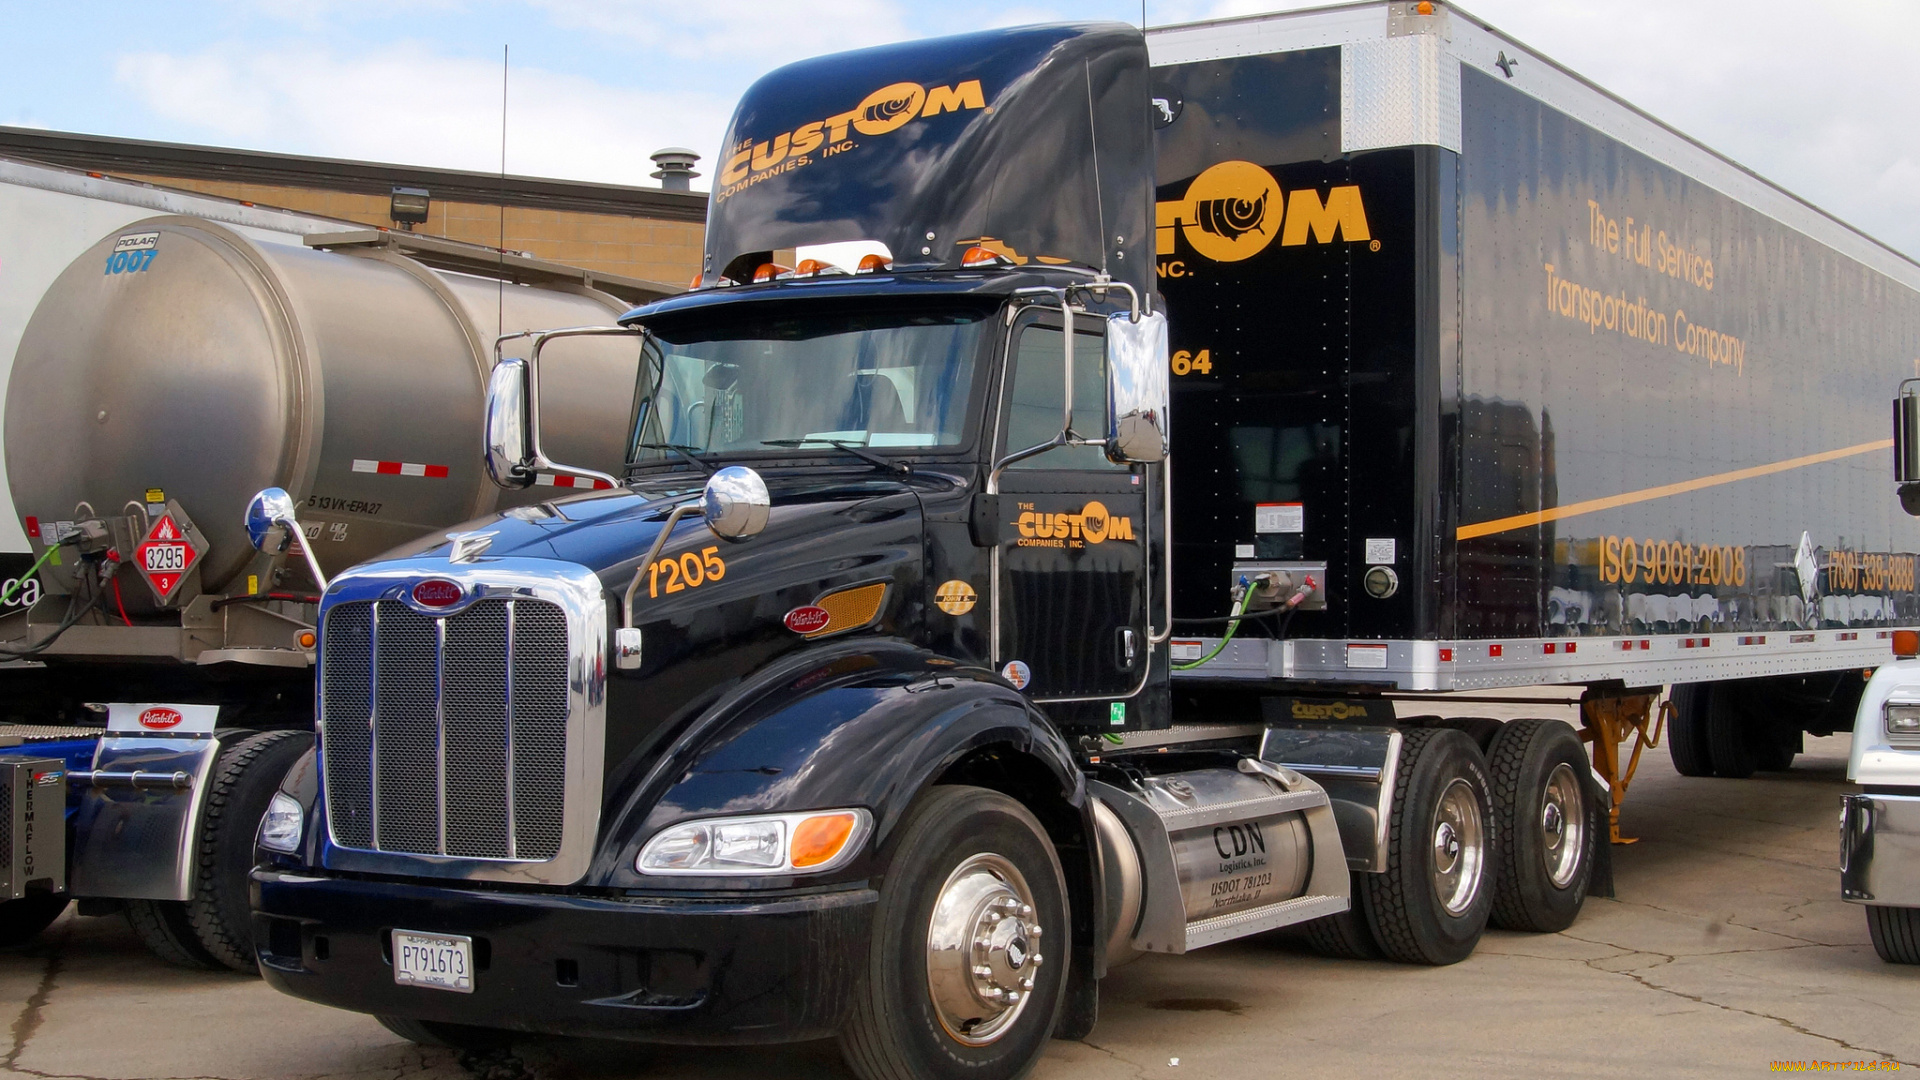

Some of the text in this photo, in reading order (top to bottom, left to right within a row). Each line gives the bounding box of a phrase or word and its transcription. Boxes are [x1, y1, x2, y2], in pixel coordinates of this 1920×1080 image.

[720, 79, 985, 187] CUSTOM
[726, 137, 753, 158] THE
[716, 141, 859, 203] COMPANIES, INC.
[1156, 161, 1371, 262] TOM
[117, 236, 157, 247] POLAR
[1588, 199, 1714, 290] The Full Service
[104, 249, 159, 275] 1007
[1545, 263, 1746, 377] Transportation Company
[1171, 349, 1212, 376] 64
[1017, 502, 1035, 511] THE
[1018, 500, 1133, 545] CUSTOM
[1017, 538, 1086, 549] COMPANIES, INC.
[147, 547, 184, 569] 3295
[1599, 535, 1746, 587] ISO 9001:2008
[1828, 549, 1914, 593] (708) 338-8888
[162, 577, 169, 590] 3
[648, 546, 726, 599] 1205
[418, 584, 457, 601] Peterbilt
[790, 611, 826, 628] Peterbilt
[142, 711, 180, 724] Peterbilt
[1291, 701, 1368, 720] CUSTOM
[23, 768, 35, 877] THERMAFLOW
[1213, 822, 1266, 859] CDN
[1210, 872, 1272, 896] USDOT 781203
[403, 946, 464, 974] P791673
